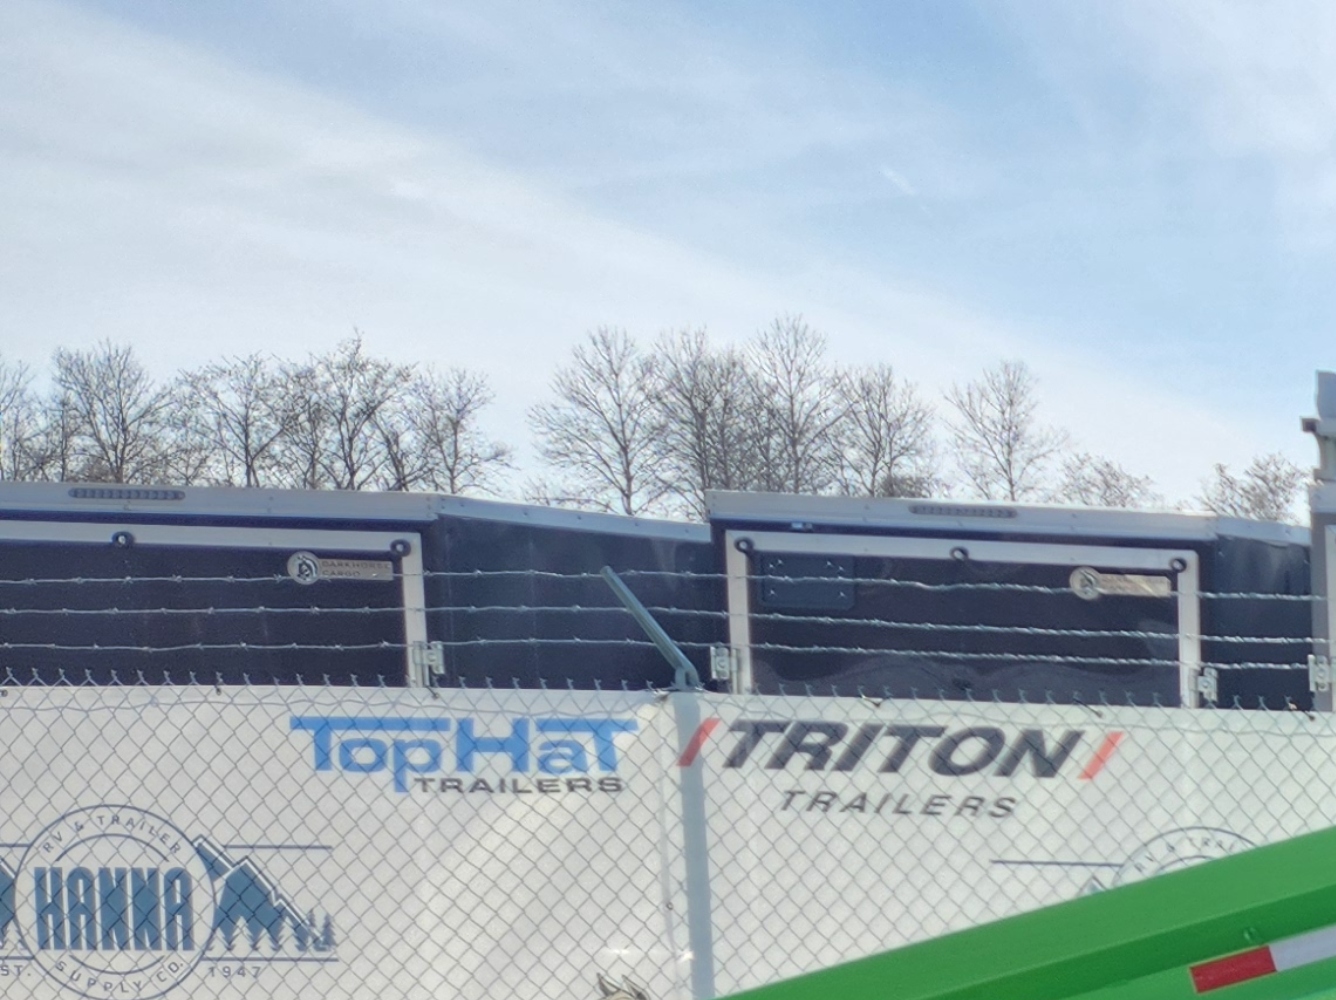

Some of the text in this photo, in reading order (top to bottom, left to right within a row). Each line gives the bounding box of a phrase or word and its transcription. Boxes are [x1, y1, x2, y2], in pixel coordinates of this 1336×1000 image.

[722, 718, 1086, 778] TRITON
[414, 777, 625, 795] TRAILERS
[781, 789, 1017, 819] TRAILERS
[42, 831, 63, 853] RV
[97, 814, 181, 855] TRAILER
[34, 866, 195, 951] HANNA
[0, 964, 31, 978] ST.
[55, 960, 143, 994] SUPPLY
[209, 965, 262, 979] 1947
